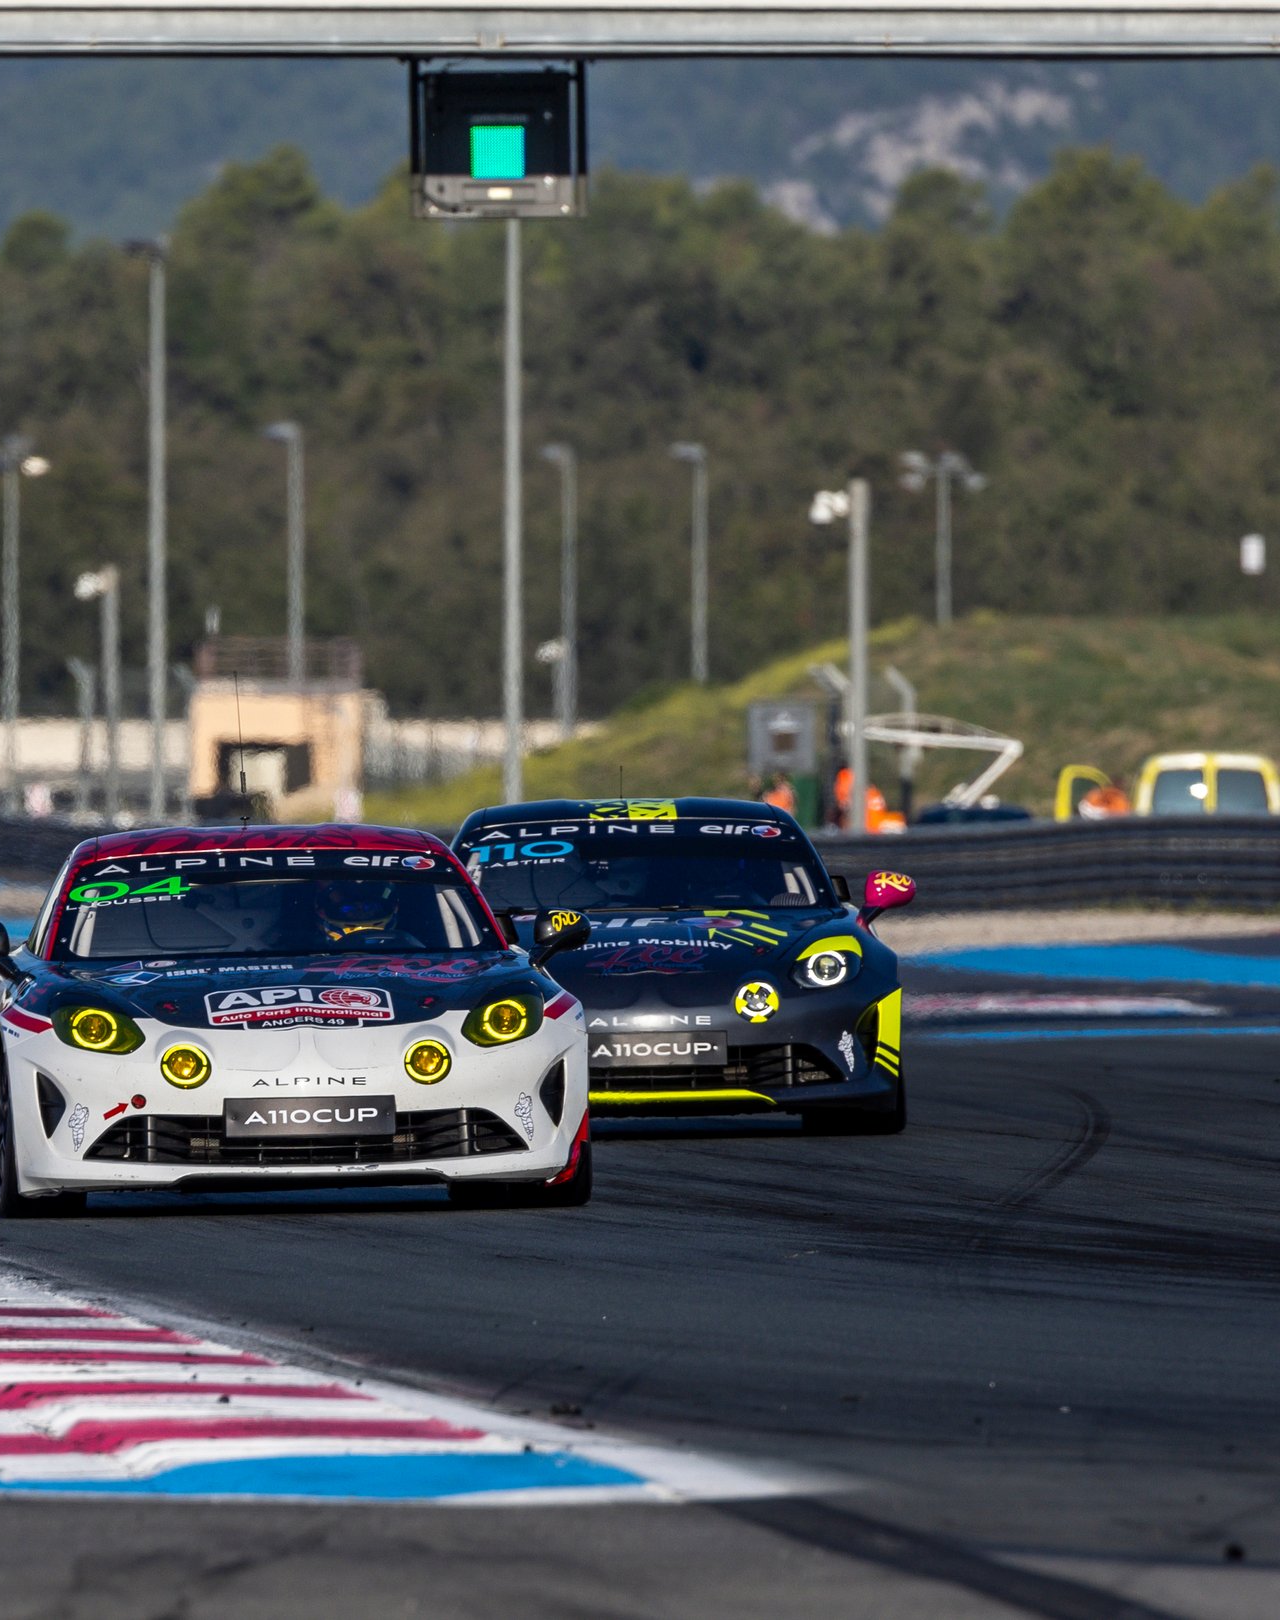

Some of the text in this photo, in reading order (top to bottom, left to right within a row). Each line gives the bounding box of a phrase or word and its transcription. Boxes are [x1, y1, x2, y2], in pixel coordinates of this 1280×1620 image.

[480, 824, 750, 841] ALPINE elf
[469, 841, 574, 863] 110
[94, 855, 400, 876] ALPINE elf
[69, 876, 192, 902] 04
[638, 937, 733, 951] Mobility
[218, 964, 294, 973] MASTER
[217, 988, 314, 1010] API
[220, 1006, 384, 1023] Auto Parts International
[261, 1016, 346, 1028] ANGERS 49
[591, 1042, 712, 1057] A110CUP
[252, 1076, 368, 1088] ALPINE
[244, 1107, 379, 1126] A110CUP
